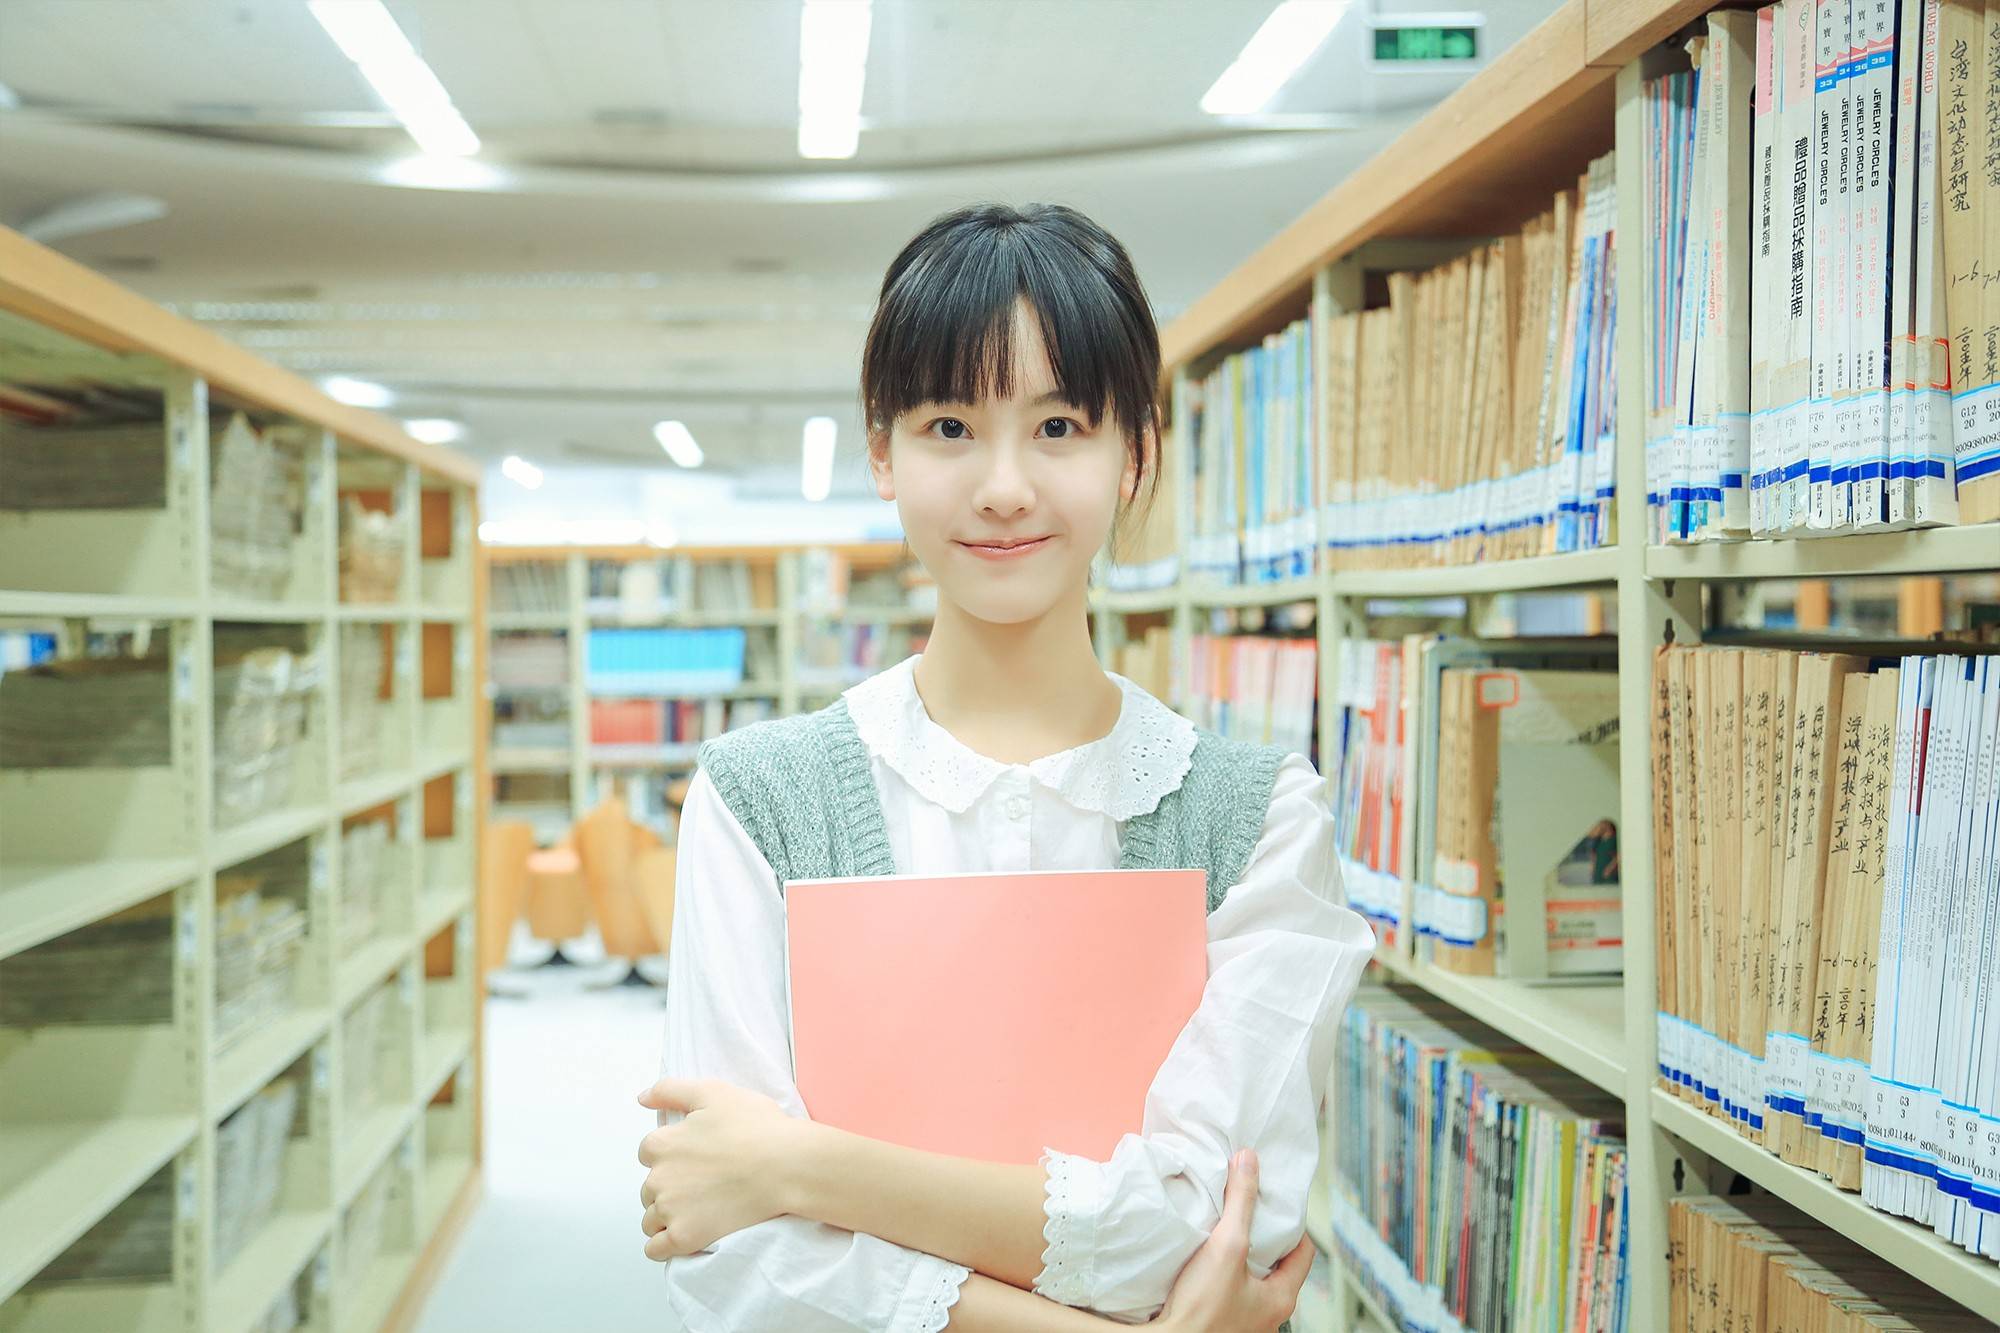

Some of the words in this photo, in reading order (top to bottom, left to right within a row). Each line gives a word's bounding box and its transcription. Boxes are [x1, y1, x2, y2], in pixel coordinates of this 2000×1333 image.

[1924, 50, 1934, 94] WORLD
[1856, 95, 1864, 142] JEWELRY
[1872, 88, 1882, 136] JEWELRY
[1840, 98, 1848, 143] JEWELRY
[1820, 110, 1829, 156] JEWELRY
[1840, 147, 1848, 194] CIRCLE'S
[1856, 146, 1864, 192] CIRCLE'S
[1871, 140, 1880, 188] CIRCLE'S
[1820, 160, 1828, 205] CIRCLE'S
[1808, 411, 1824, 423] F76
[1836, 411, 1850, 424] F76
[1960, 404, 1976, 418] G12
[1813, 424, 1818, 432] 8
[1964, 418, 1975, 430] 20
[1900, 1096, 1910, 1106] G3
[1900, 1109, 1906, 1118] 3
[1966, 1122, 1978, 1132] G3
[1949, 1130, 1954, 1139] 3
[1968, 1136, 1974, 1145] 3
[1990, 1146, 1996, 1156] 3
